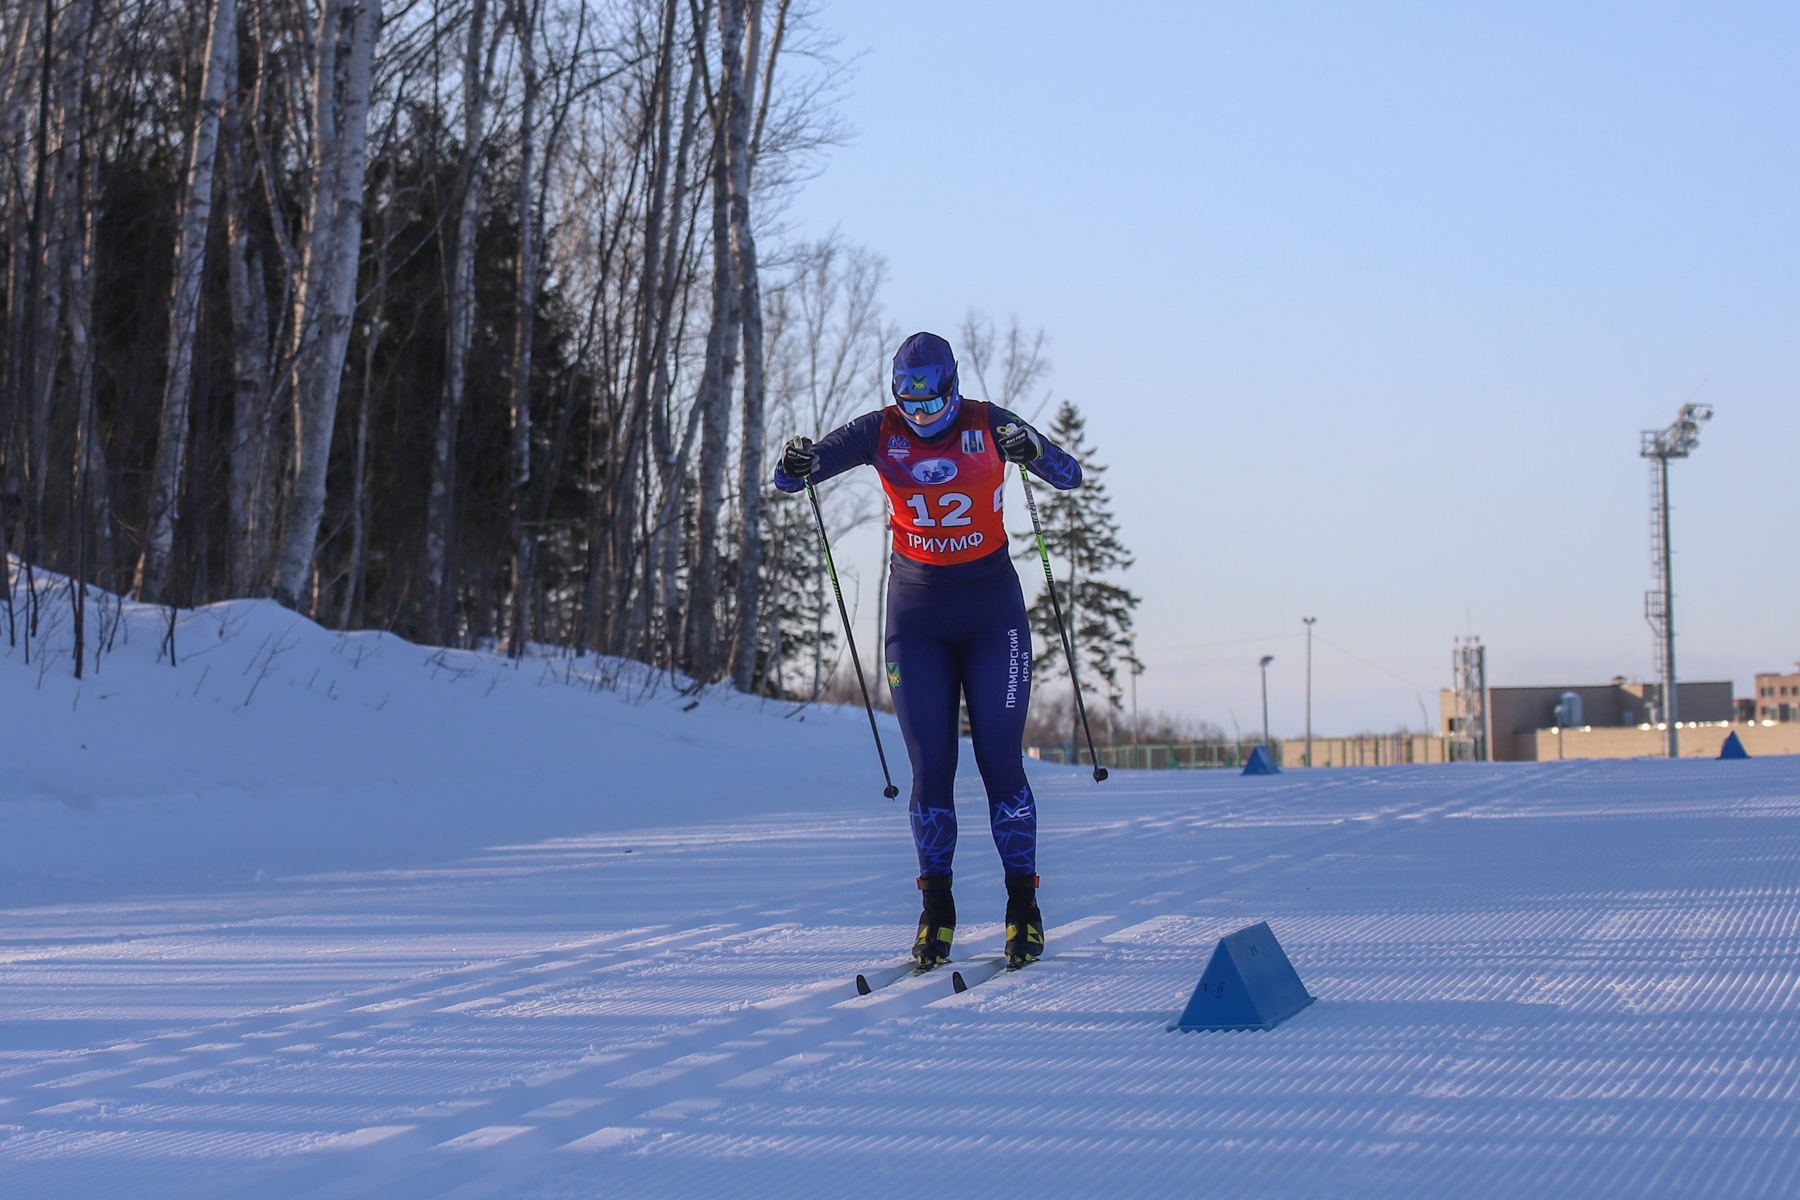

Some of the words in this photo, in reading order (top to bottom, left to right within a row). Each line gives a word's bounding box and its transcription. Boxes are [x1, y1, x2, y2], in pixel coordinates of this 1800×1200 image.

[906, 492, 973, 527] 12
[906, 531, 984, 553] ТРИУМФ
[1005, 628, 1019, 708] ПРИМОРСКИЙ
[1021, 651, 1029, 682] КРАЙ
